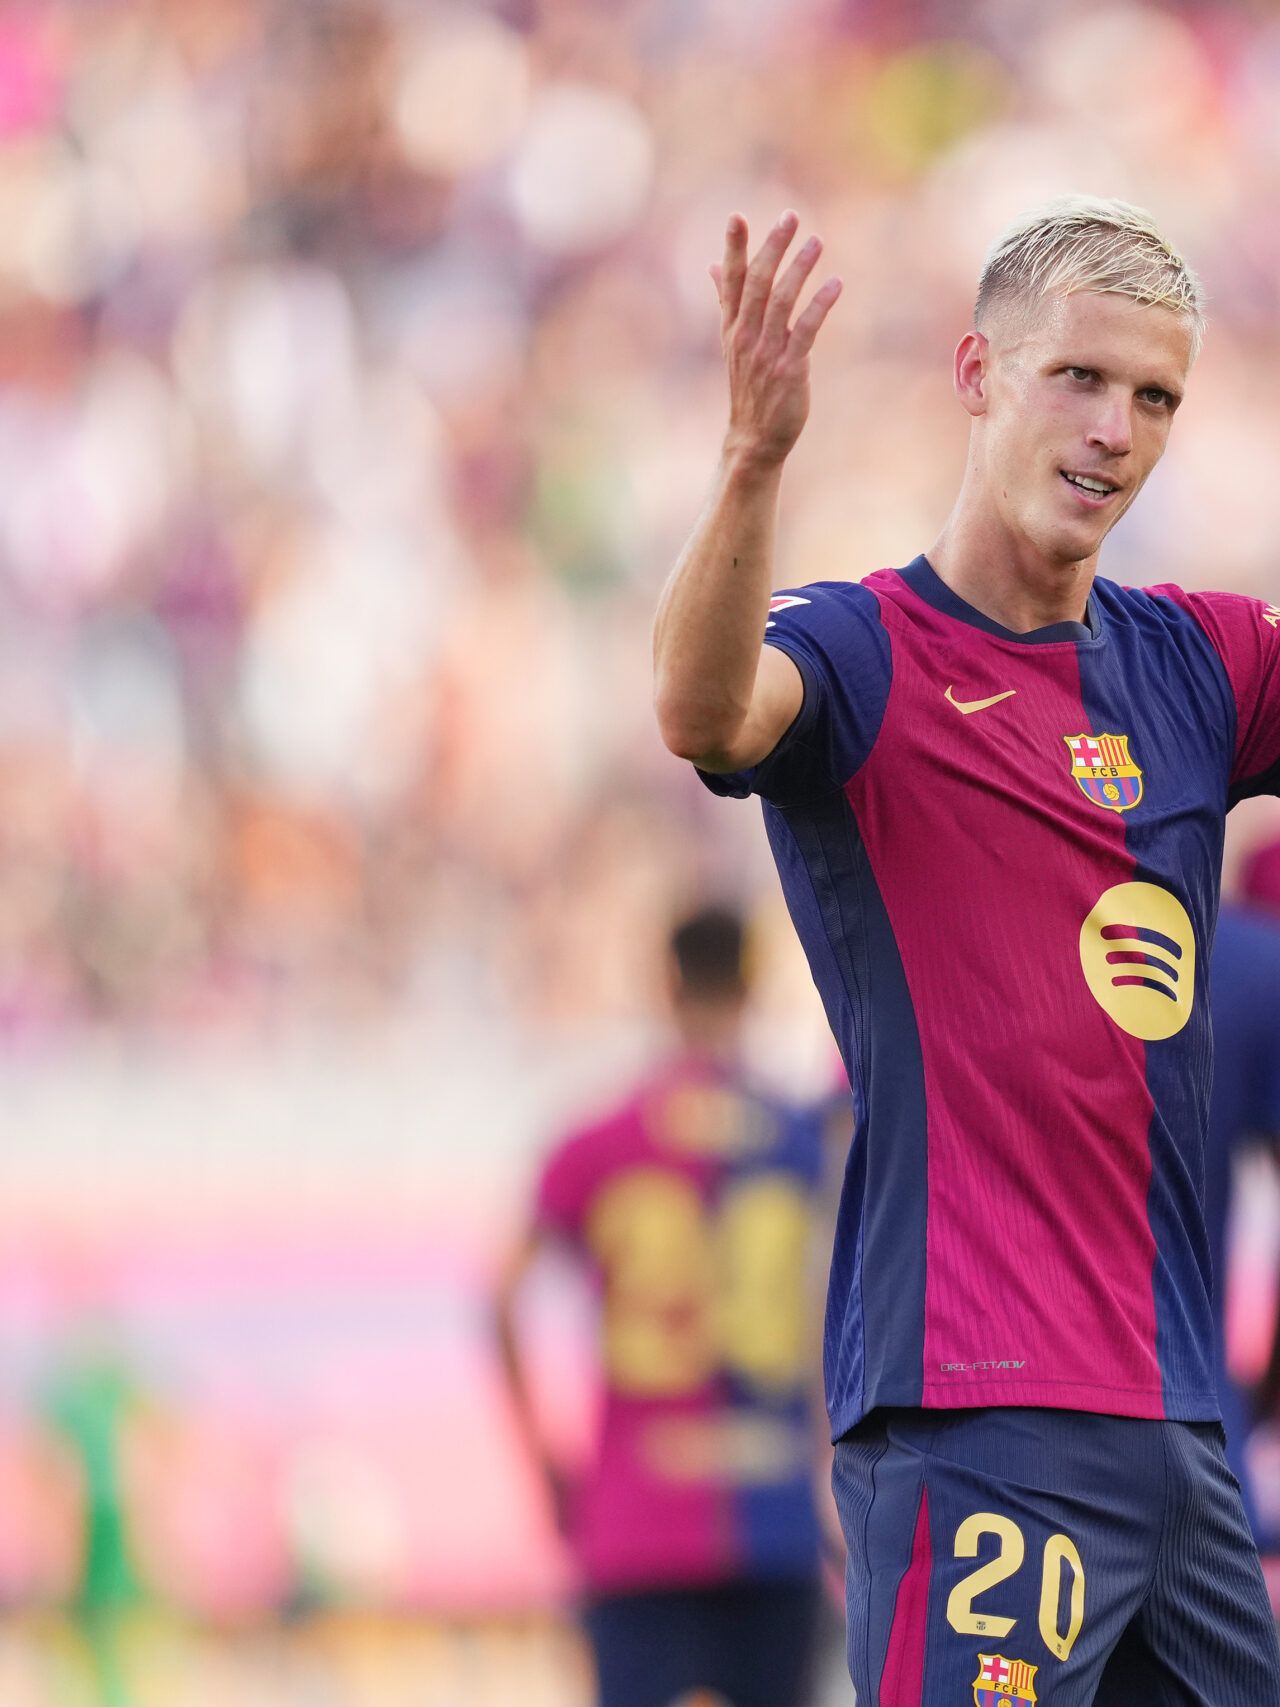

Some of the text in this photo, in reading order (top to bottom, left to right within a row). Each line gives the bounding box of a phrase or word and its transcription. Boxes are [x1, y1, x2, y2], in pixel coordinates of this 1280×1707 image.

[1090, 767, 1119, 777] FCB
[946, 1512, 1085, 1662] 20
[993, 1682, 1019, 1696] FCB
